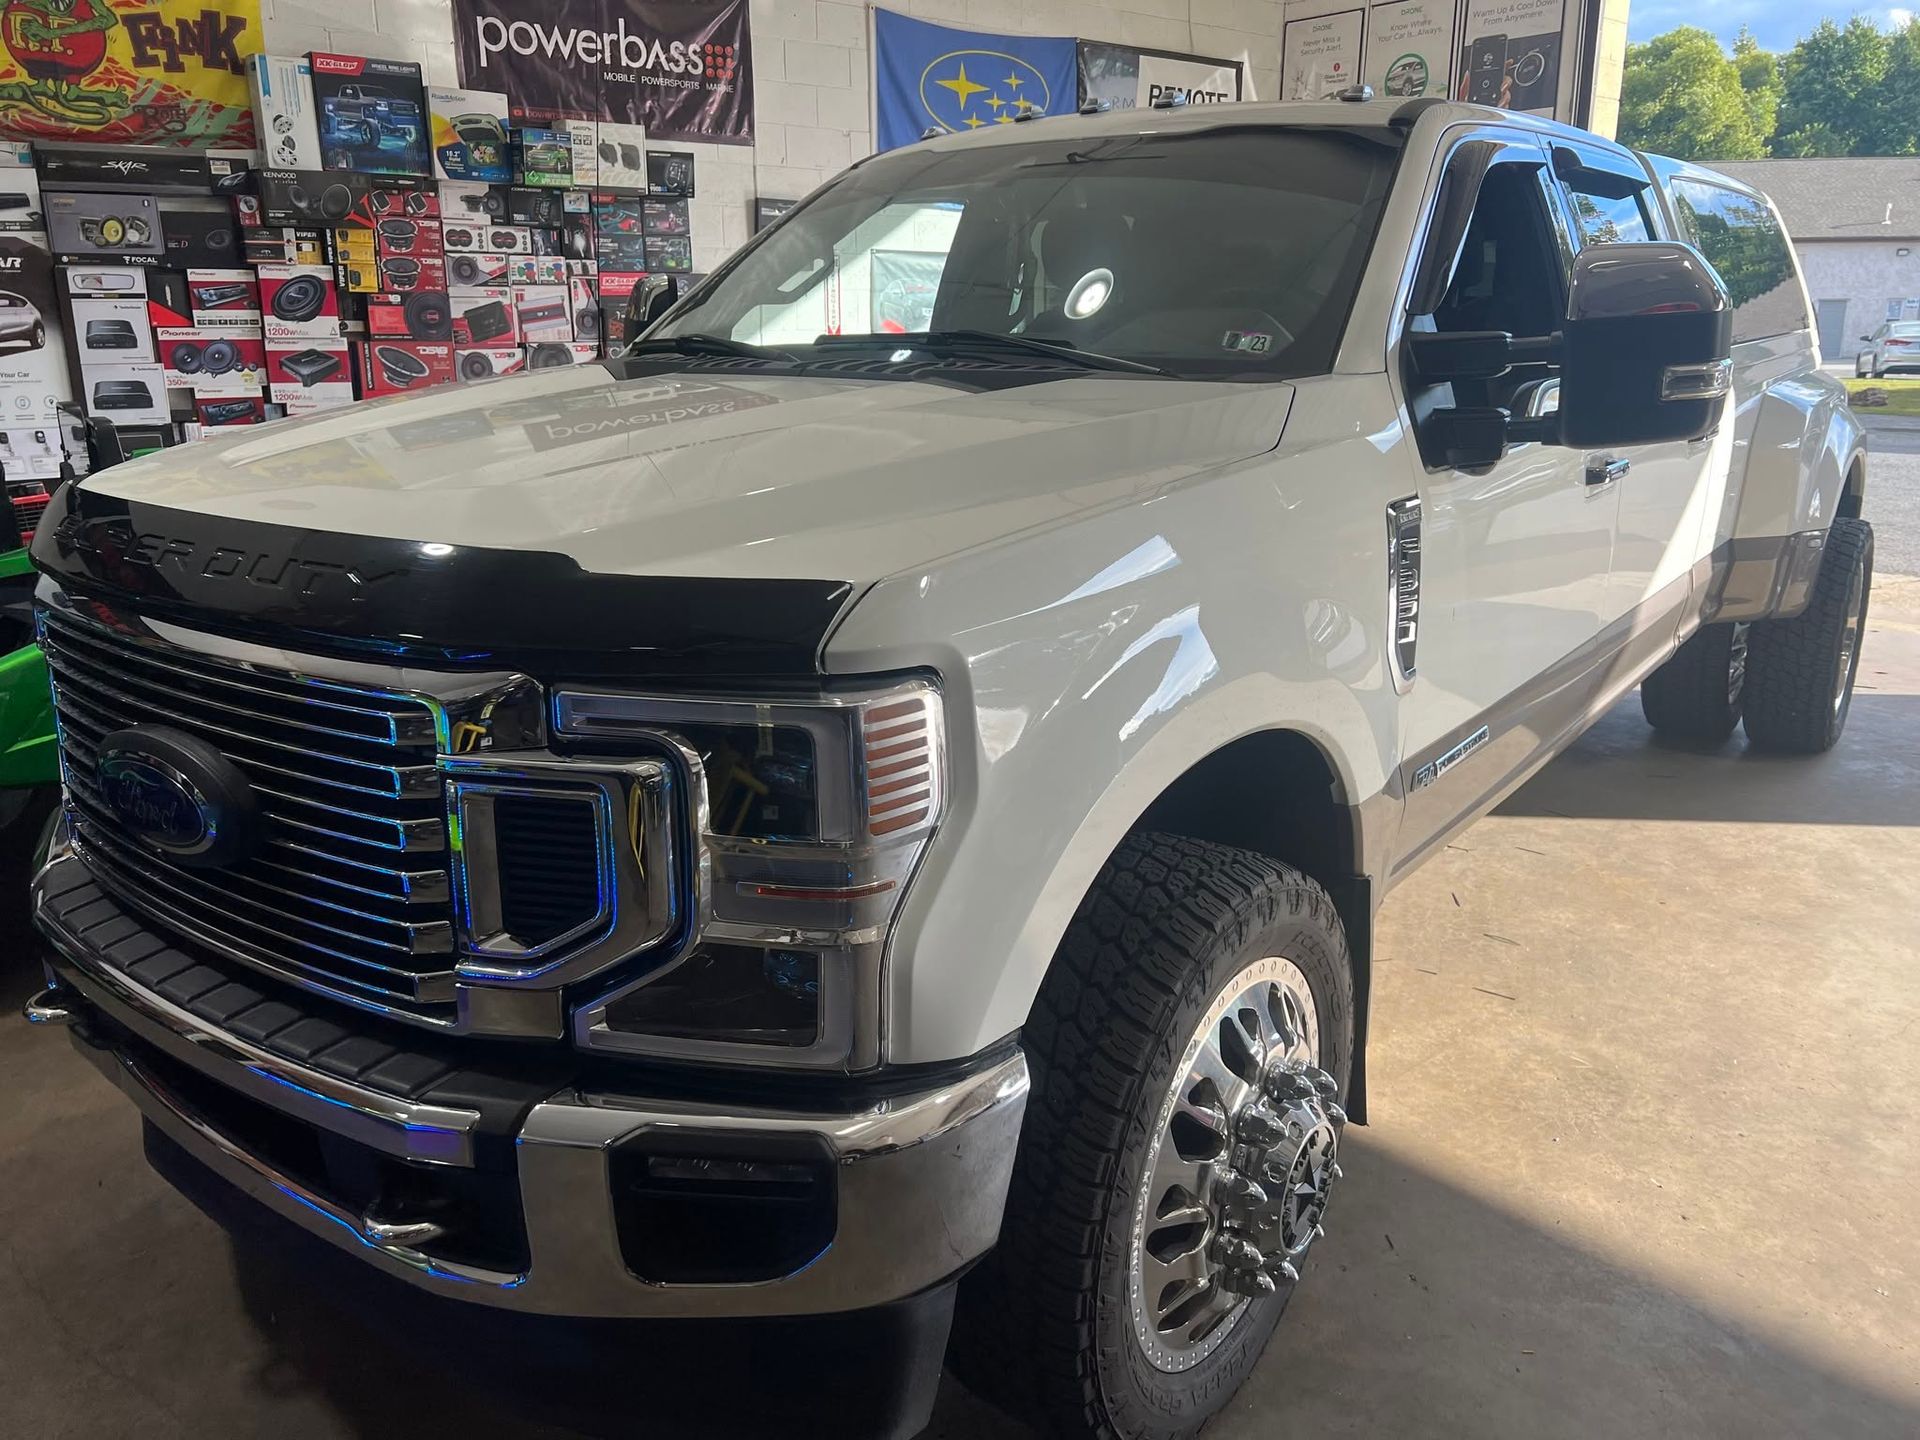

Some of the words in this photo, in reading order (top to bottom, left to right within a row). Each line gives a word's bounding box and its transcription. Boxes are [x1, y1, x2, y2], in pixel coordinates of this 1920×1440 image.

[1400, 6, 1424, 15] DRONE
[1473, 8, 1495, 18] Warm
[1497, 7, 1508, 15] Up
[1516, 2, 1534, 11] Cool
[1483, 15, 1503, 25] From
[1312, 23, 1334, 32] DRONE
[1390, 22, 1408, 32] Know
[1394, 32, 1407, 40] Car
[1303, 38, 1321, 47] Never
[1300, 46, 1325, 56] Security
[603, 72, 636, 84] MOBILE
[641, 76, 700, 90] POWERSPORTS
[1149, 84, 1228, 106] RMOTE
[263, 171, 297, 179] KENWOOD
[160, 329, 202, 338] Pioneer
[1251, 336, 1267, 351] 23
